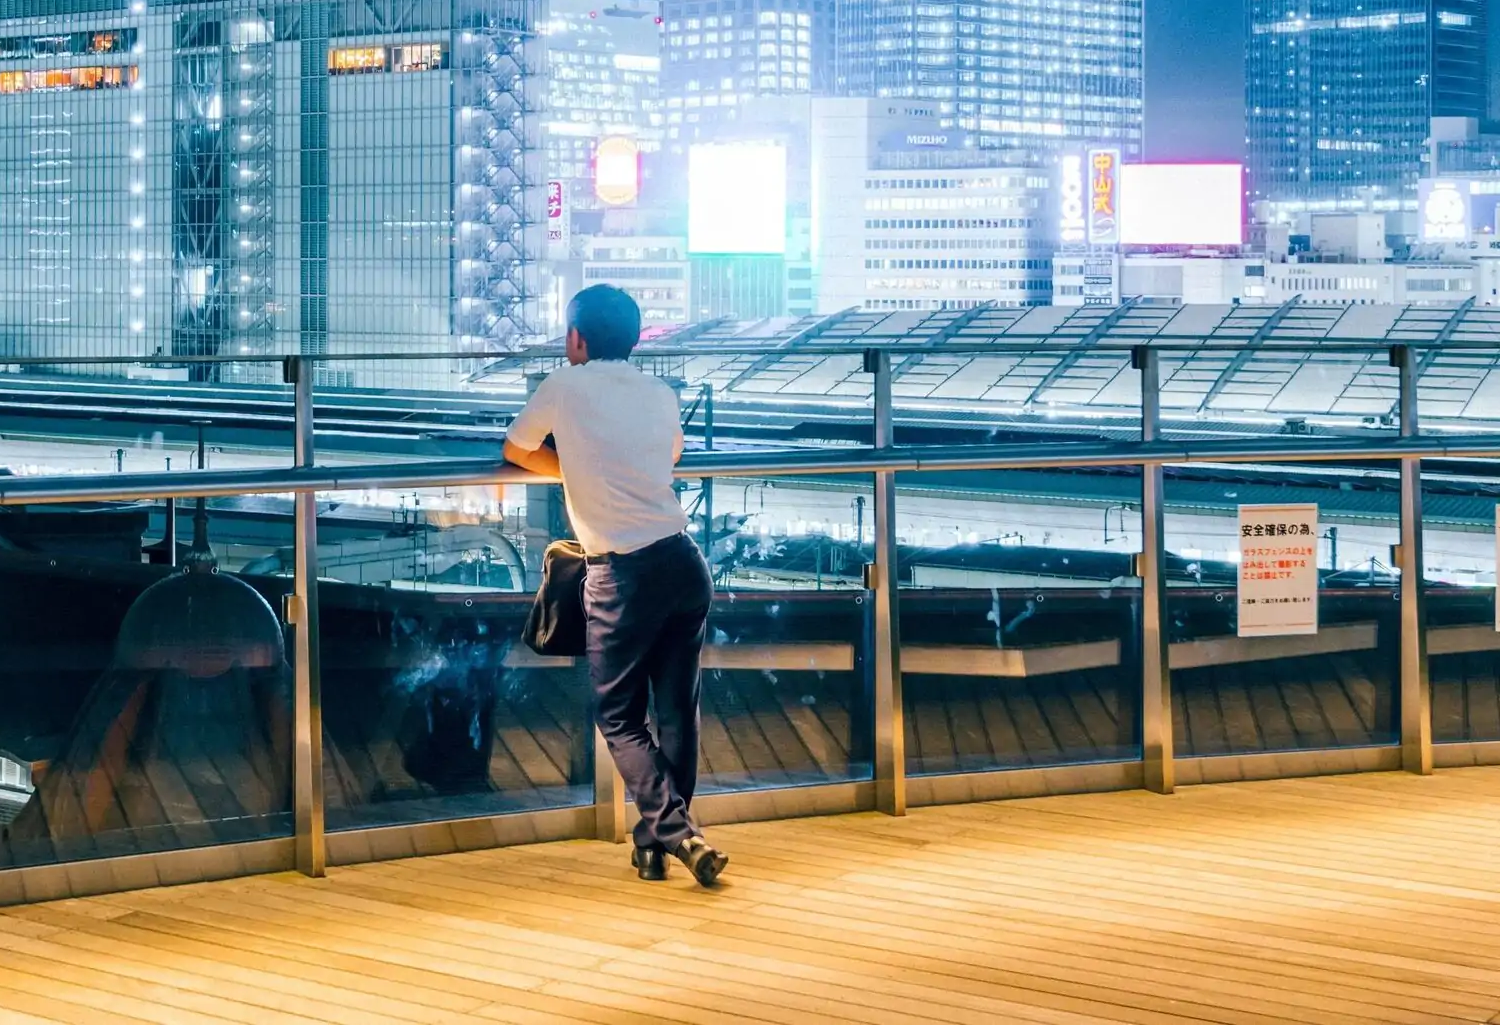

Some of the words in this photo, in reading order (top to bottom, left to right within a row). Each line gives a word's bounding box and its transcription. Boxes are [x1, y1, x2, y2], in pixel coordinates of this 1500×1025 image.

[906, 135, 947, 145] MIZUHO
[1092, 153, 1115, 216] 中山式
[1241, 523, 1315, 537] 安全確保の為、
